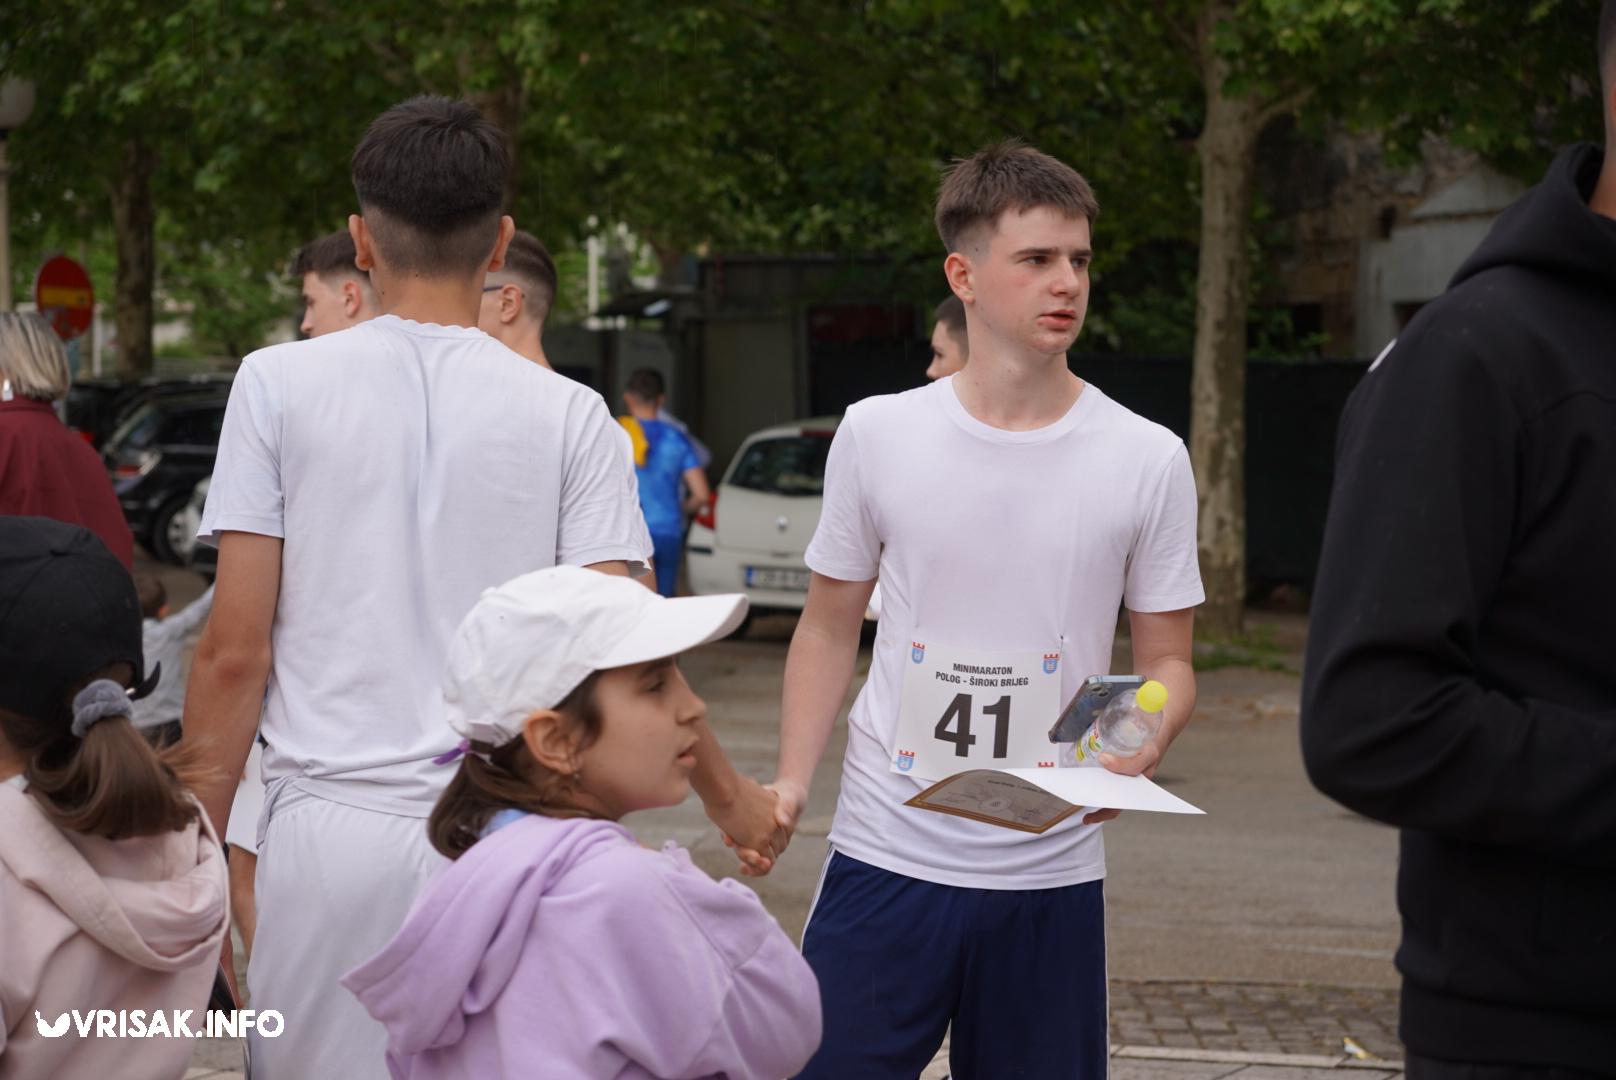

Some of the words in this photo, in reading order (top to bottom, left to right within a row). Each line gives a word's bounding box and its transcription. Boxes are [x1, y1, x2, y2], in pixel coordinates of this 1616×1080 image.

[953, 663, 1013, 675] MINIMARATON
[935, 671, 961, 684] POLOG
[969, 676, 998, 687] ŠIROKI
[1000, 677, 1029, 687] BRIJEG
[934, 693, 1011, 759] 41
